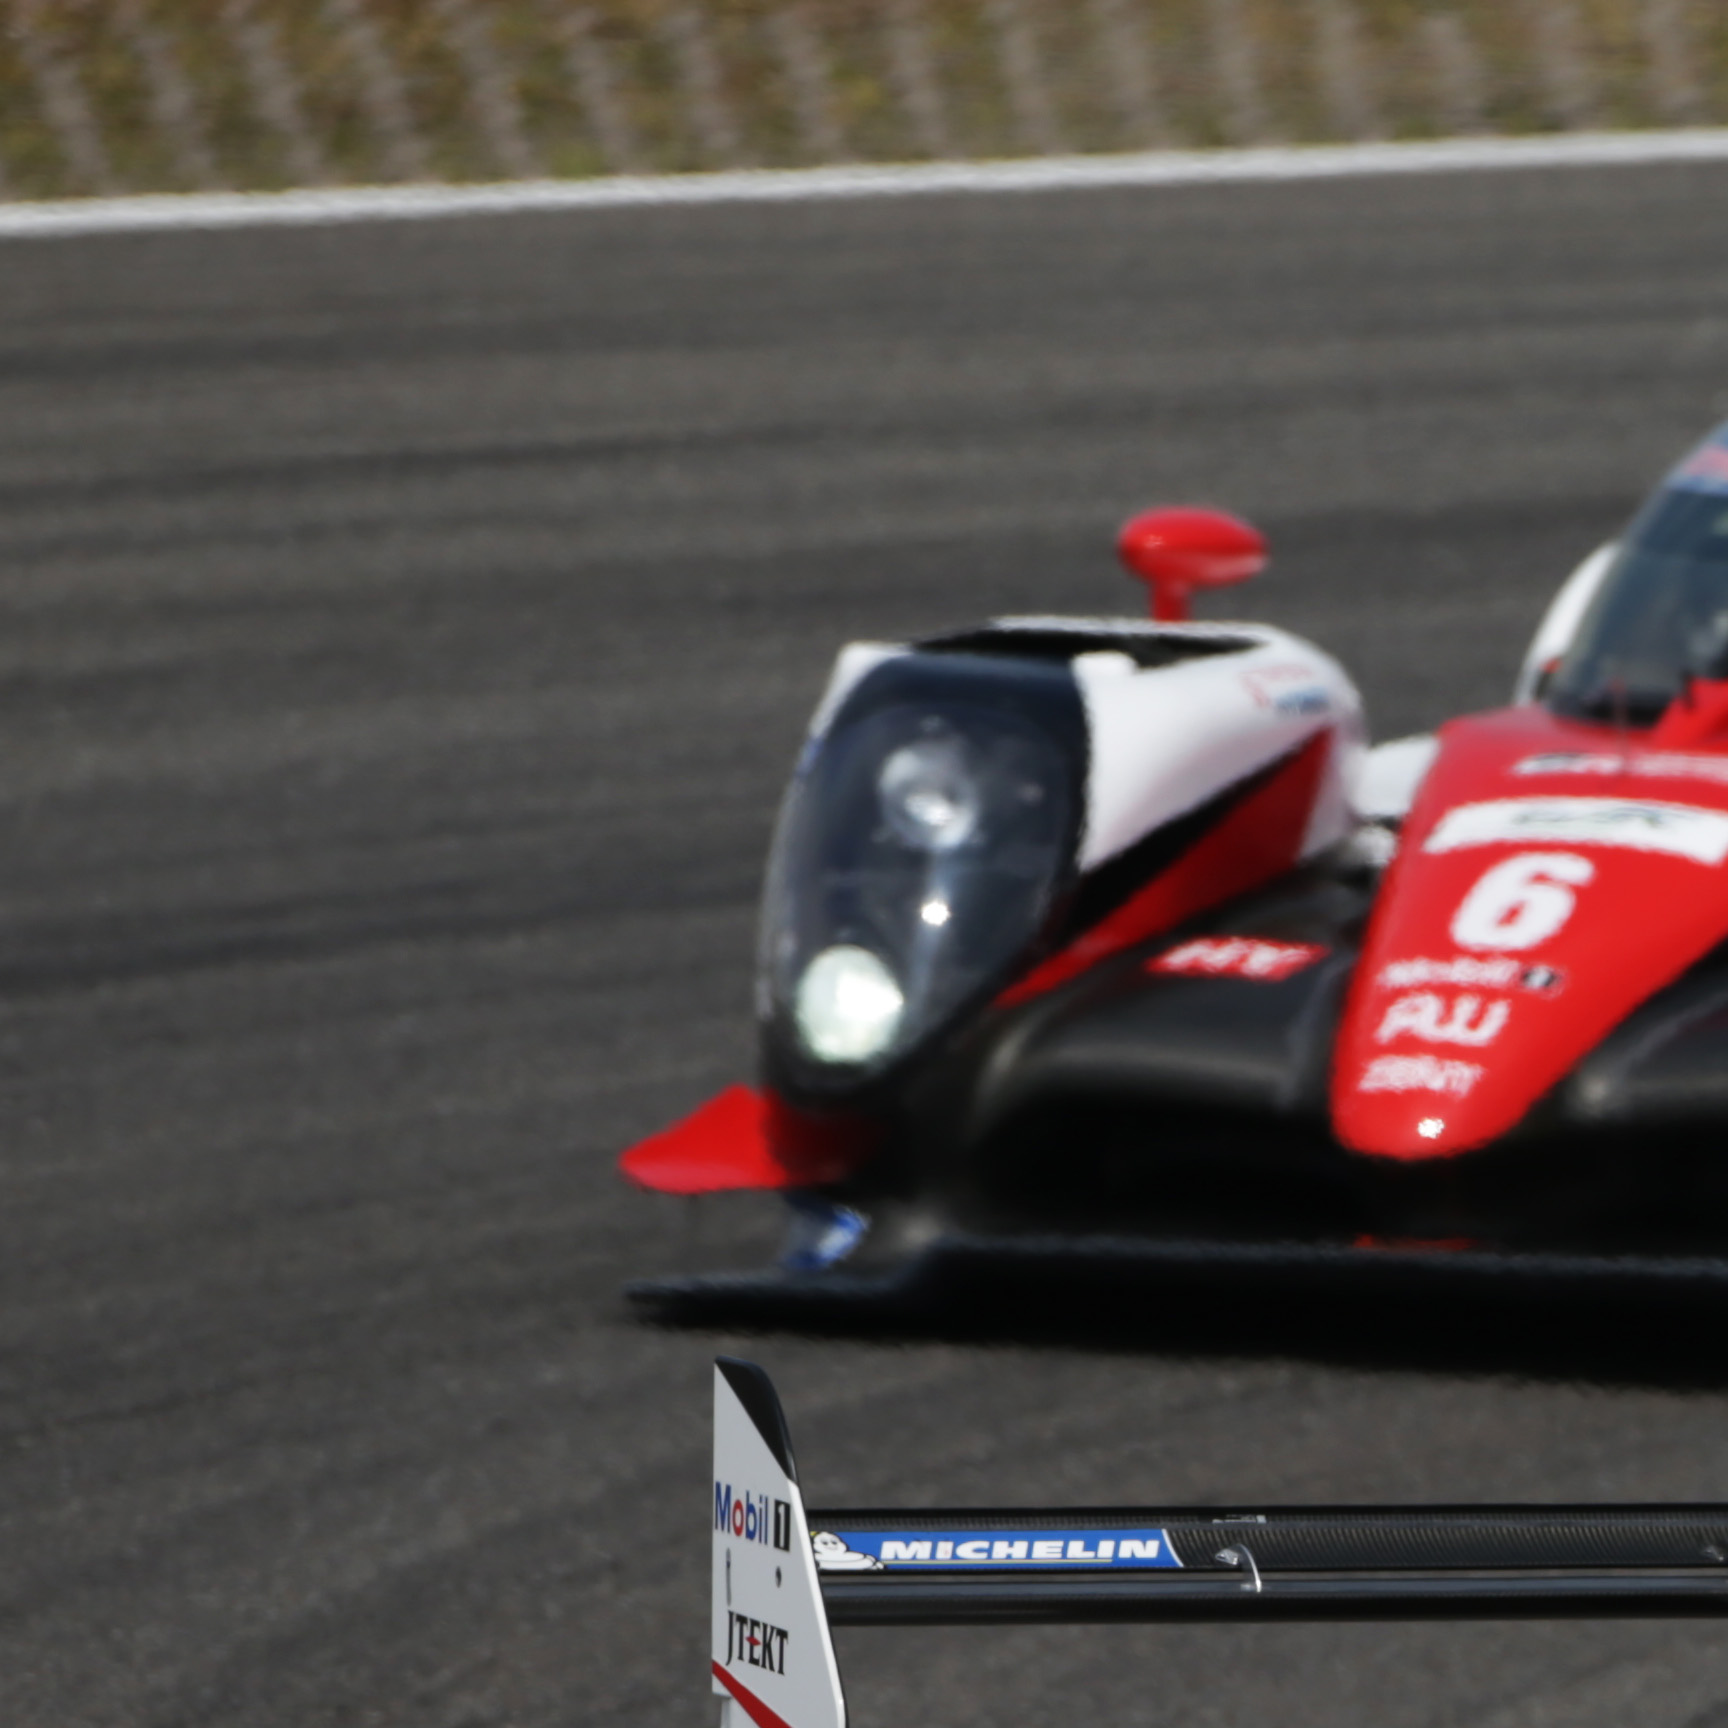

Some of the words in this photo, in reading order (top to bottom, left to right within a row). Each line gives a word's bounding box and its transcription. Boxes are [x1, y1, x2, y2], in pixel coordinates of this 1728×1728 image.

[1449, 852, 1596, 951] 6
[714, 1481, 768, 1546] Mobil
[774, 1499, 791, 1552] 1
[880, 1540, 1160, 1561] MICHELIN
[726, 1610, 788, 1676] JTEKT
